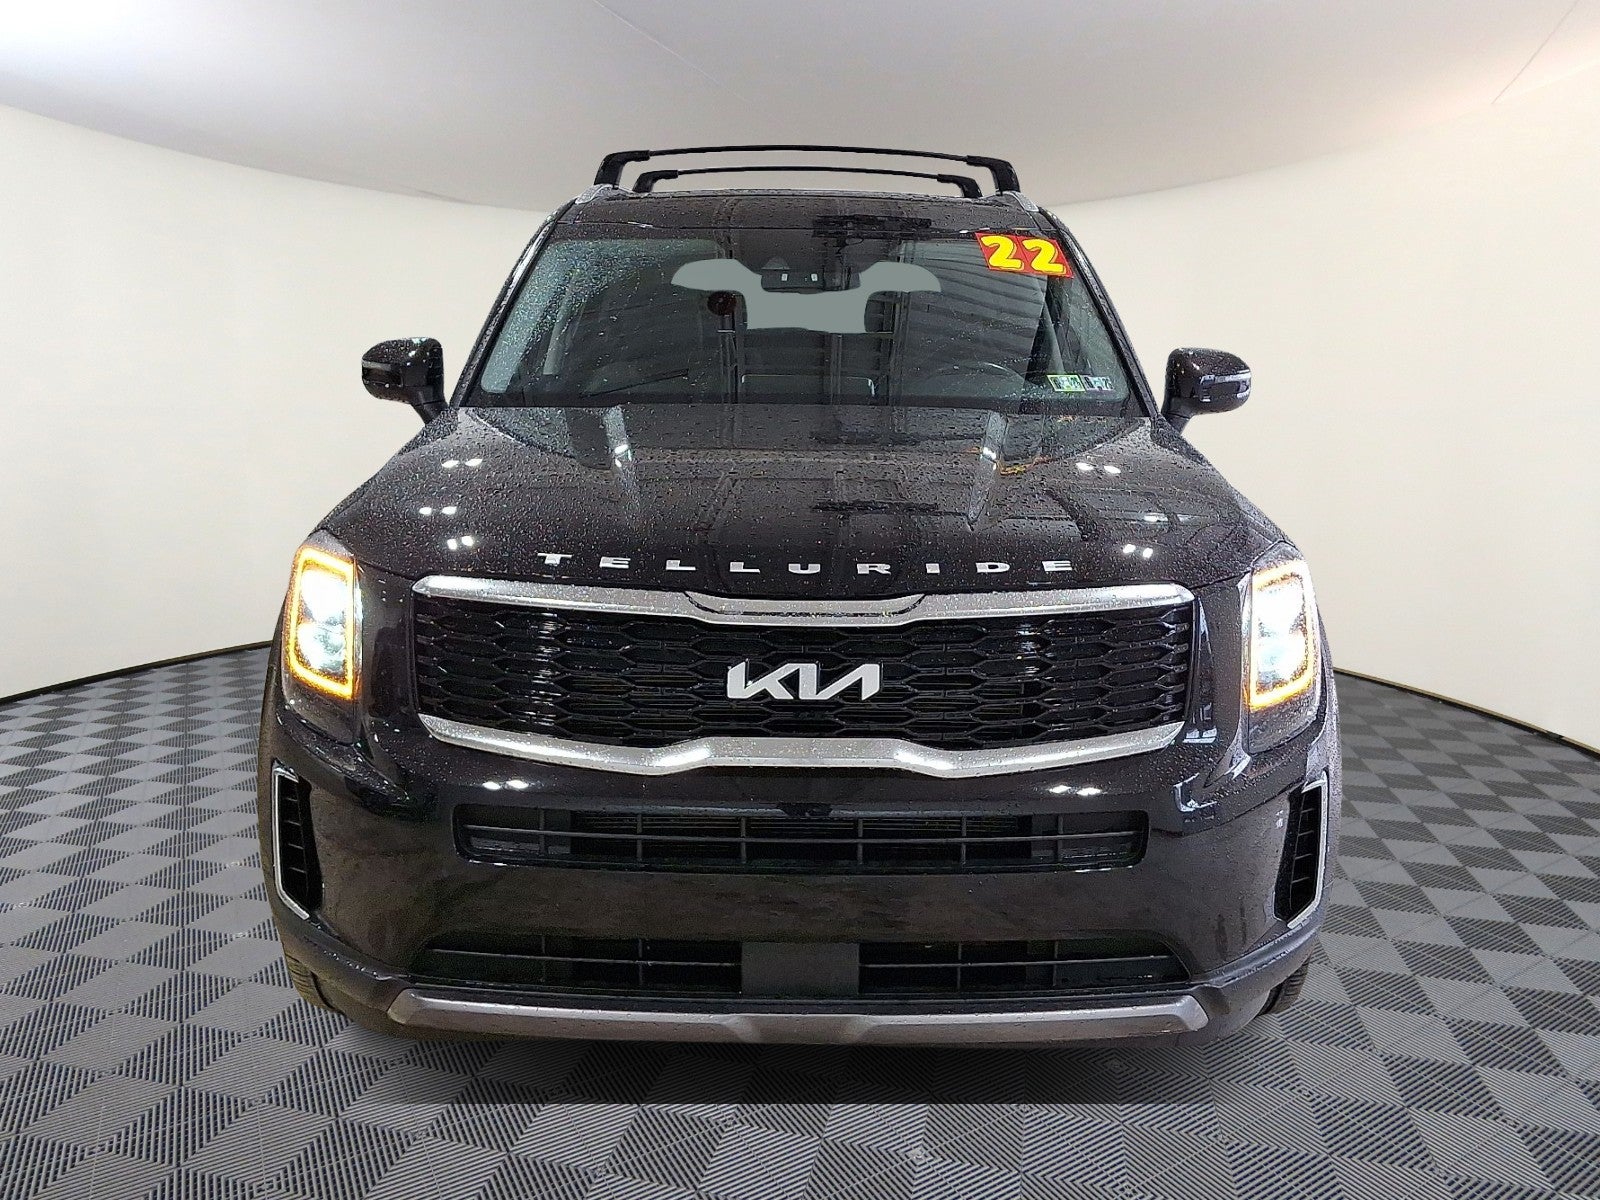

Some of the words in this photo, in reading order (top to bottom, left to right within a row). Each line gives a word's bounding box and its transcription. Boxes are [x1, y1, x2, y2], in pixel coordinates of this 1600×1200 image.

[980, 234, 1066, 274] 22
[537, 552, 1074, 575] TELLURIDE
[726, 660, 881, 701] KIA
